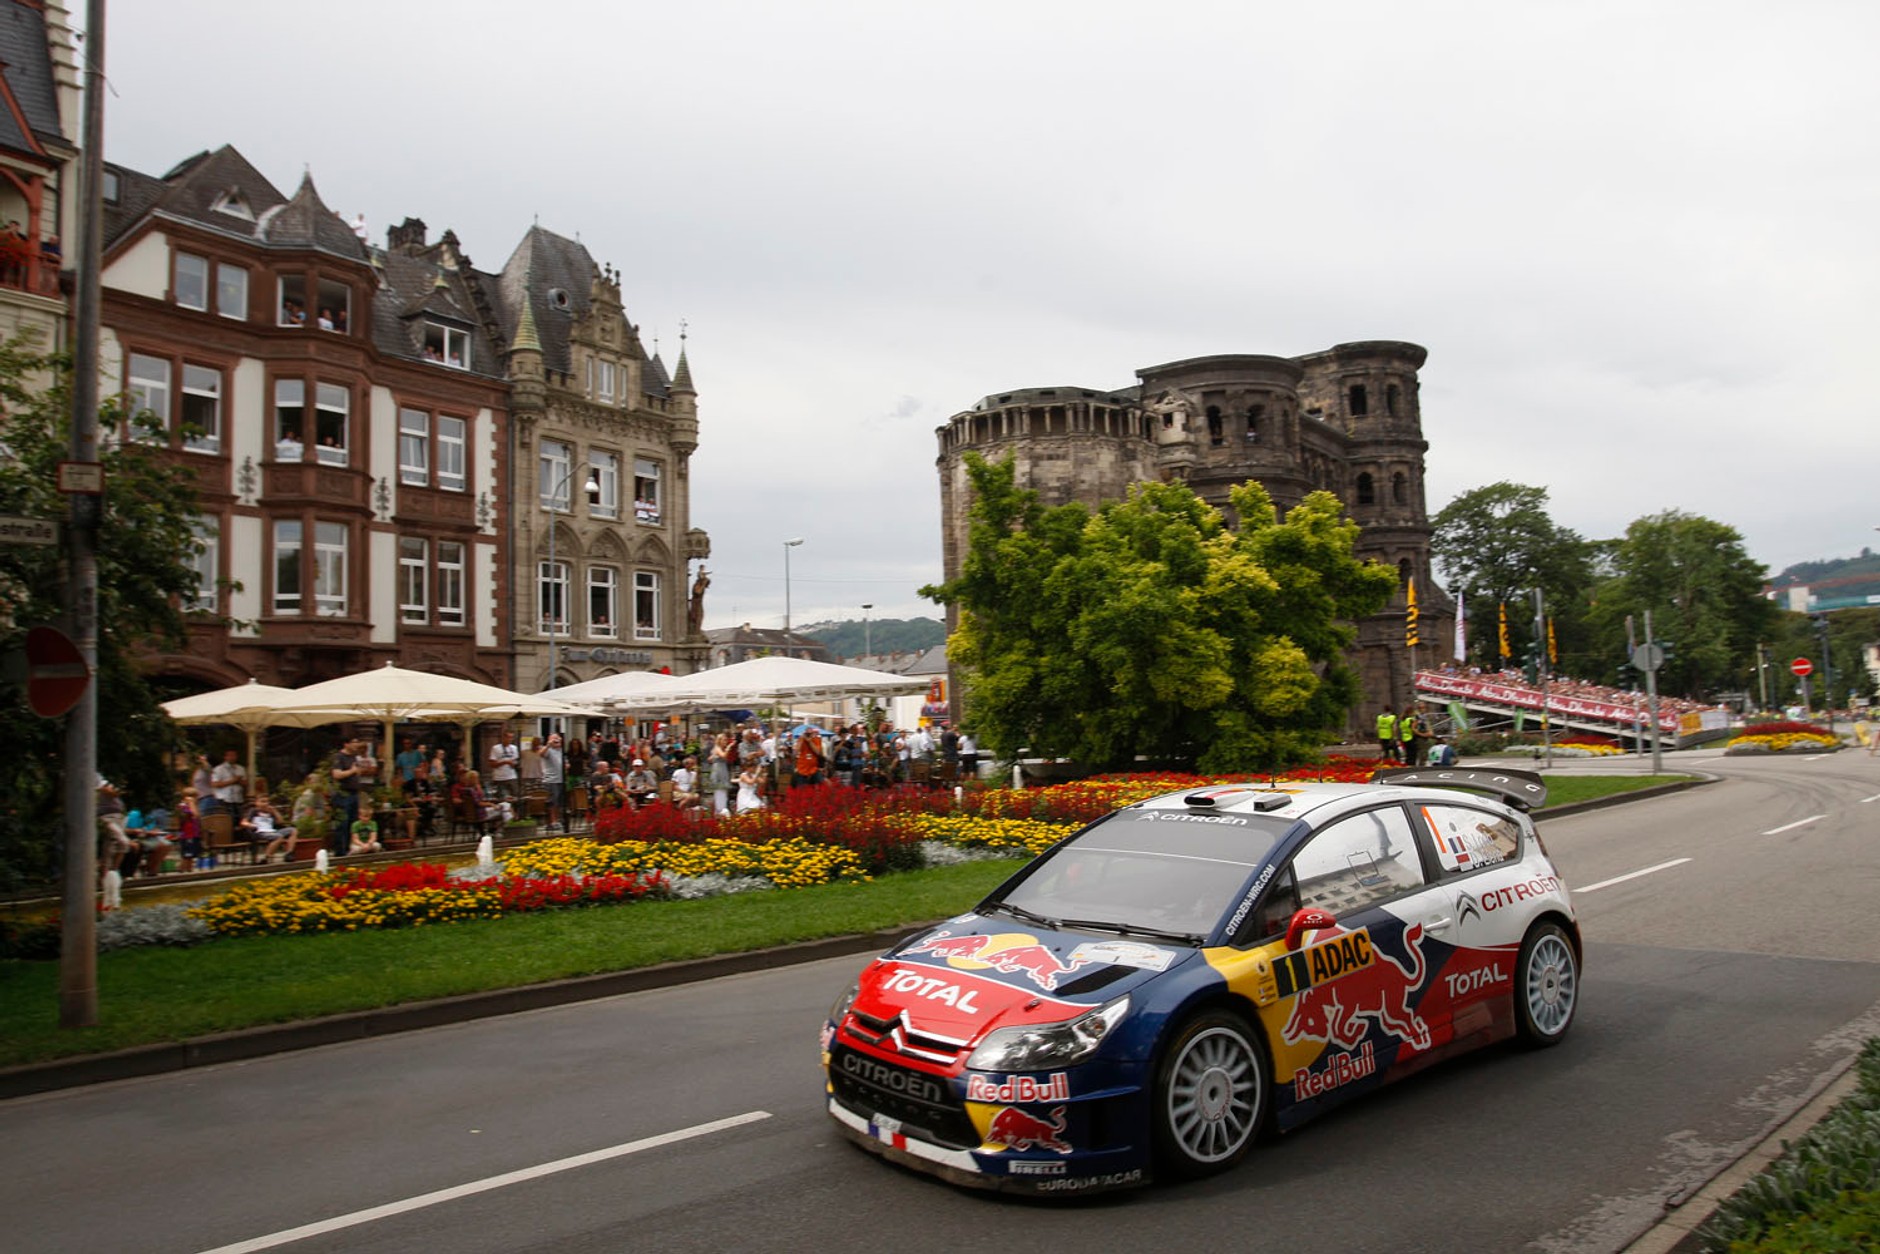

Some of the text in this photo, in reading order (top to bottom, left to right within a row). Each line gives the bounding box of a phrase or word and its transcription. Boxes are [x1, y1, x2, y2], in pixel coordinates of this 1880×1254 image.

[1224, 863, 1276, 937] CITROEN-WRC.COM
[1285, 956, 1298, 996] 1
[1311, 932, 1370, 982] ADAC
[1445, 963, 1508, 998] TOTAL
[883, 969, 979, 1014] TOTAL
[967, 1072, 1070, 1102] Red Bull
[1295, 1041, 1375, 1101] Red Bull
[1008, 1160, 1067, 1174] PIRELLI
